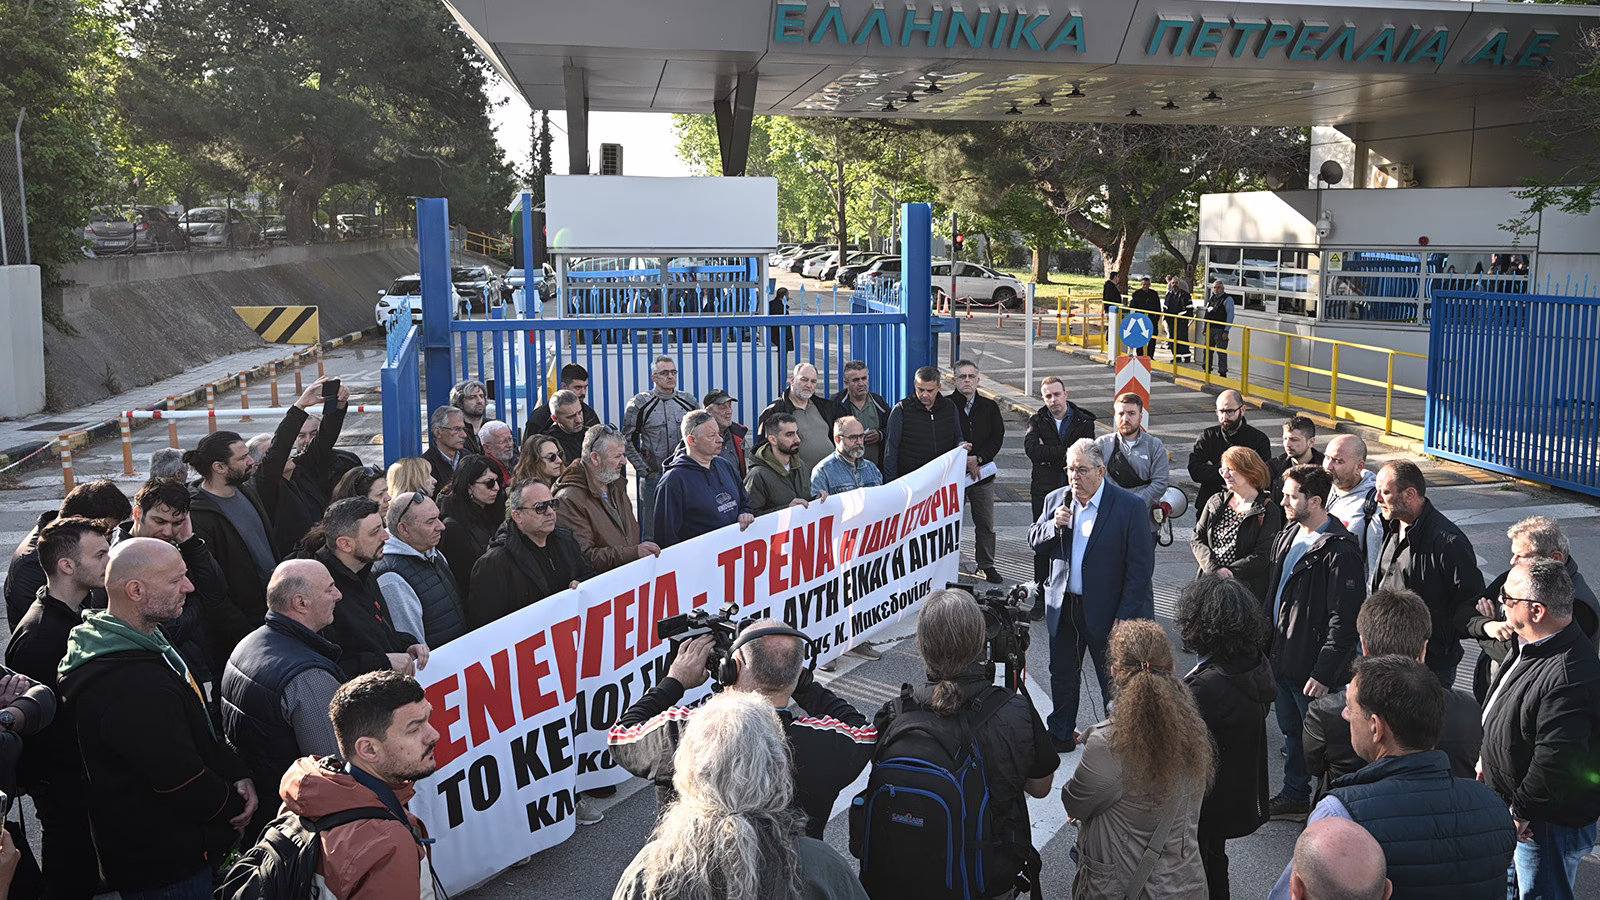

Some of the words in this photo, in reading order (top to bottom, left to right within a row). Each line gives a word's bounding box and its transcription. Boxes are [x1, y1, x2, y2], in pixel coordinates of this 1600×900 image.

[774, 3, 1086, 53] ΕΛΛΗΝΙΚΑ
[1146, 17, 1450, 64] ΠΕΤΡΕΛΑΙΑ
[718, 515, 835, 607] ΤΡΕΝΑ
[840, 528, 859, 565] Η
[858, 513, 901, 557] ΙΔΙΑ
[900, 483, 960, 540] ΙΣΤΟΡΙΑ
[834, 622, 848, 646] Κ.
[851, 577, 932, 637] Μακεδονίας
[437, 755, 501, 829] ΤΟ
[783, 577, 839, 632] ΑΥΤΗ
[843, 552, 890, 608] ΕΙΝΑΙ
[892, 544, 906, 580] Η
[909, 520, 960, 573] ΑΙΤΙΑ!
